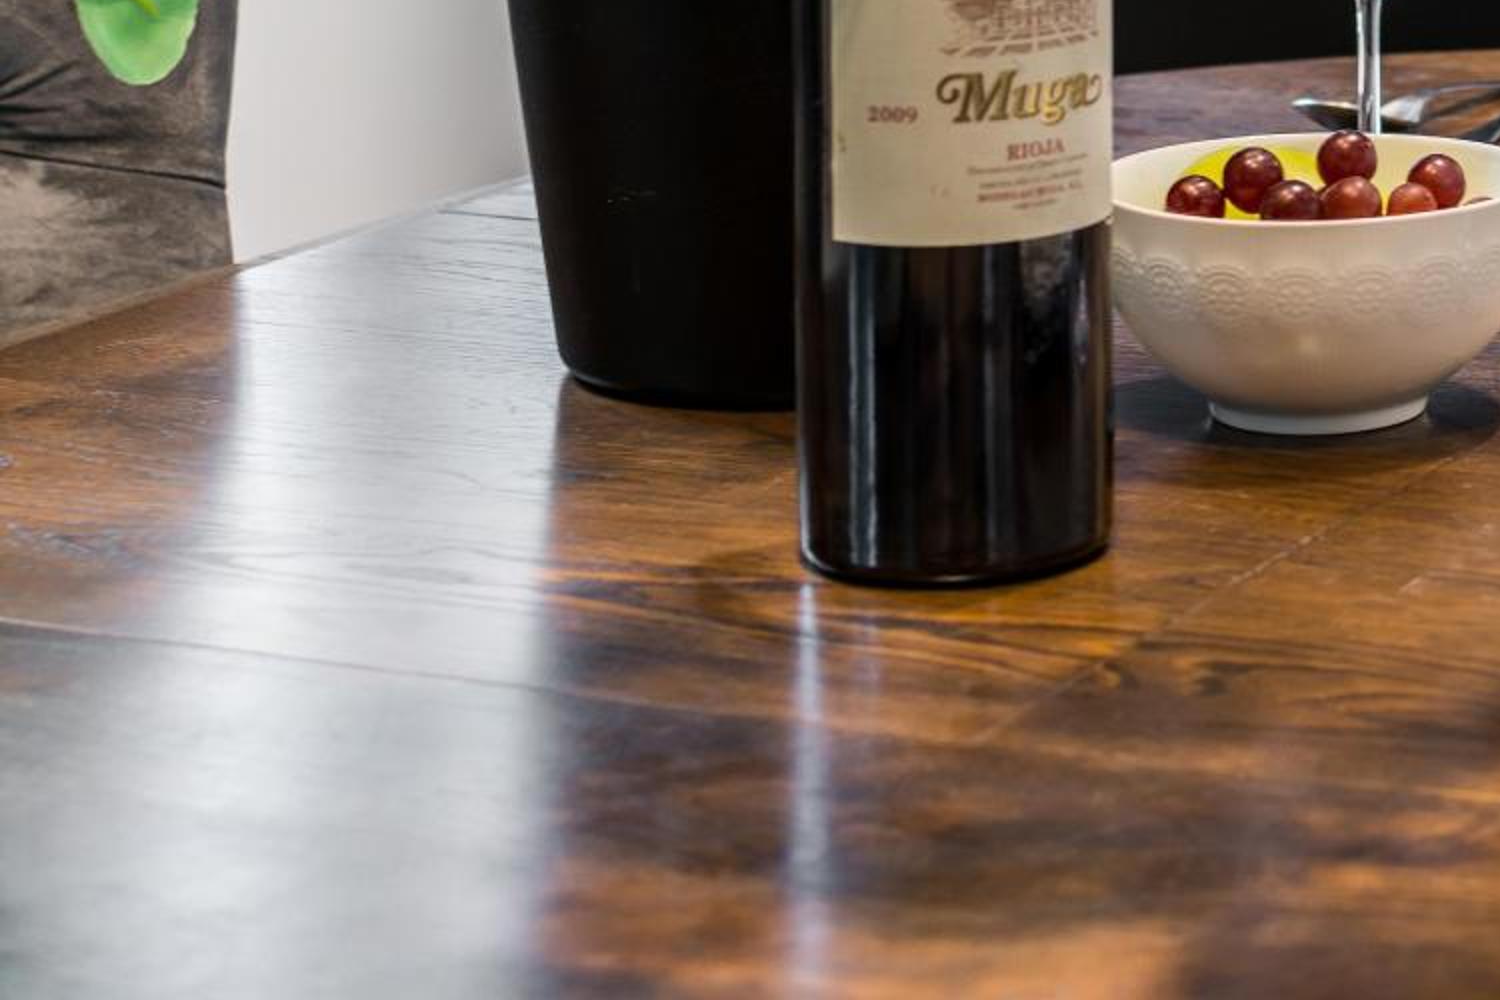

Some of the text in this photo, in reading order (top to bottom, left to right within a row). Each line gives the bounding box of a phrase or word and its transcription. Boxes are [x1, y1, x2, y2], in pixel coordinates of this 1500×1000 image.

[937, 69, 1102, 125] Muga
[867, 105, 919, 123] 2009
[1006, 138, 1065, 161] RIOJA
